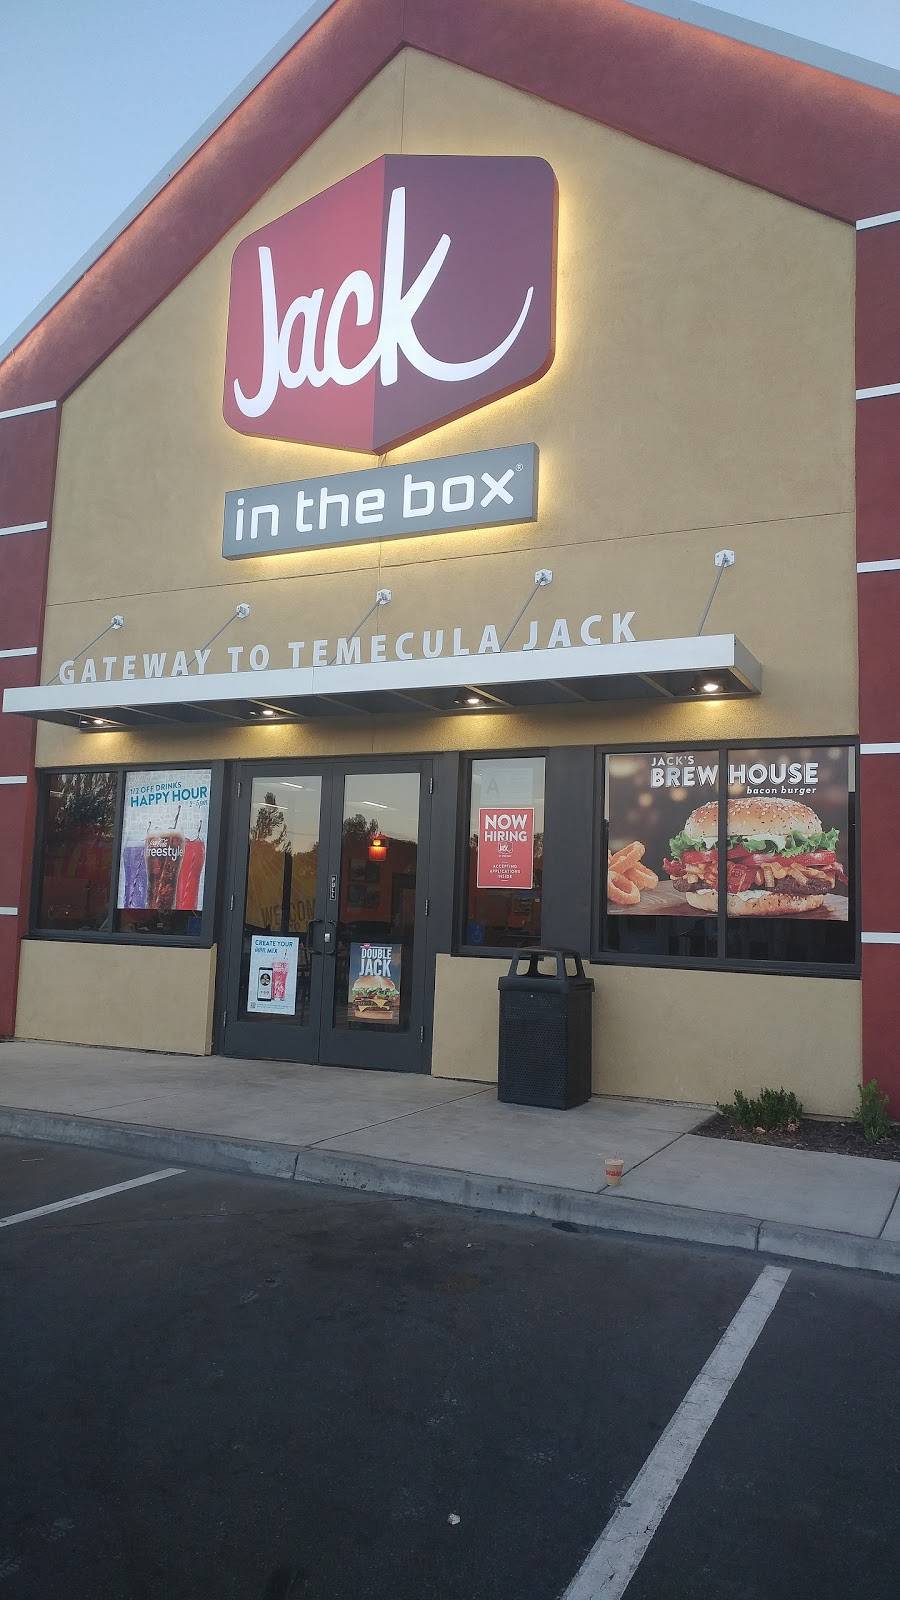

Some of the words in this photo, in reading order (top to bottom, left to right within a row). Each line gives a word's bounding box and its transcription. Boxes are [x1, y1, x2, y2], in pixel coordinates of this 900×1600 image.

[234, 186, 534, 418] Jack
[235, 497, 279, 541] in
[296, 487, 385, 533] the
[402, 468, 515, 519] box
[59, 649, 212, 685] GATEWAY
[227, 644, 270, 673] TO
[288, 624, 501, 669] TEMECULA
[522, 611, 636, 651] JACK
[651, 755, 695, 767] JACK'S
[650, 764, 719, 788] BREW
[727, 762, 819, 786] HOUSE
[140, 785, 154, 793] OFF
[155, 782, 182, 791] DRINKS
[746, 785, 778, 795] bacon
[780, 785, 817, 796] burger
[130, 791, 170, 807] HAPPY
[172, 786, 208, 802] HOUR
[484, 814, 528, 830] NOW
[484, 831, 528, 842] HIRING
[361, 948, 392, 960] DOUBLE
[359, 958, 392, 977] JACK
